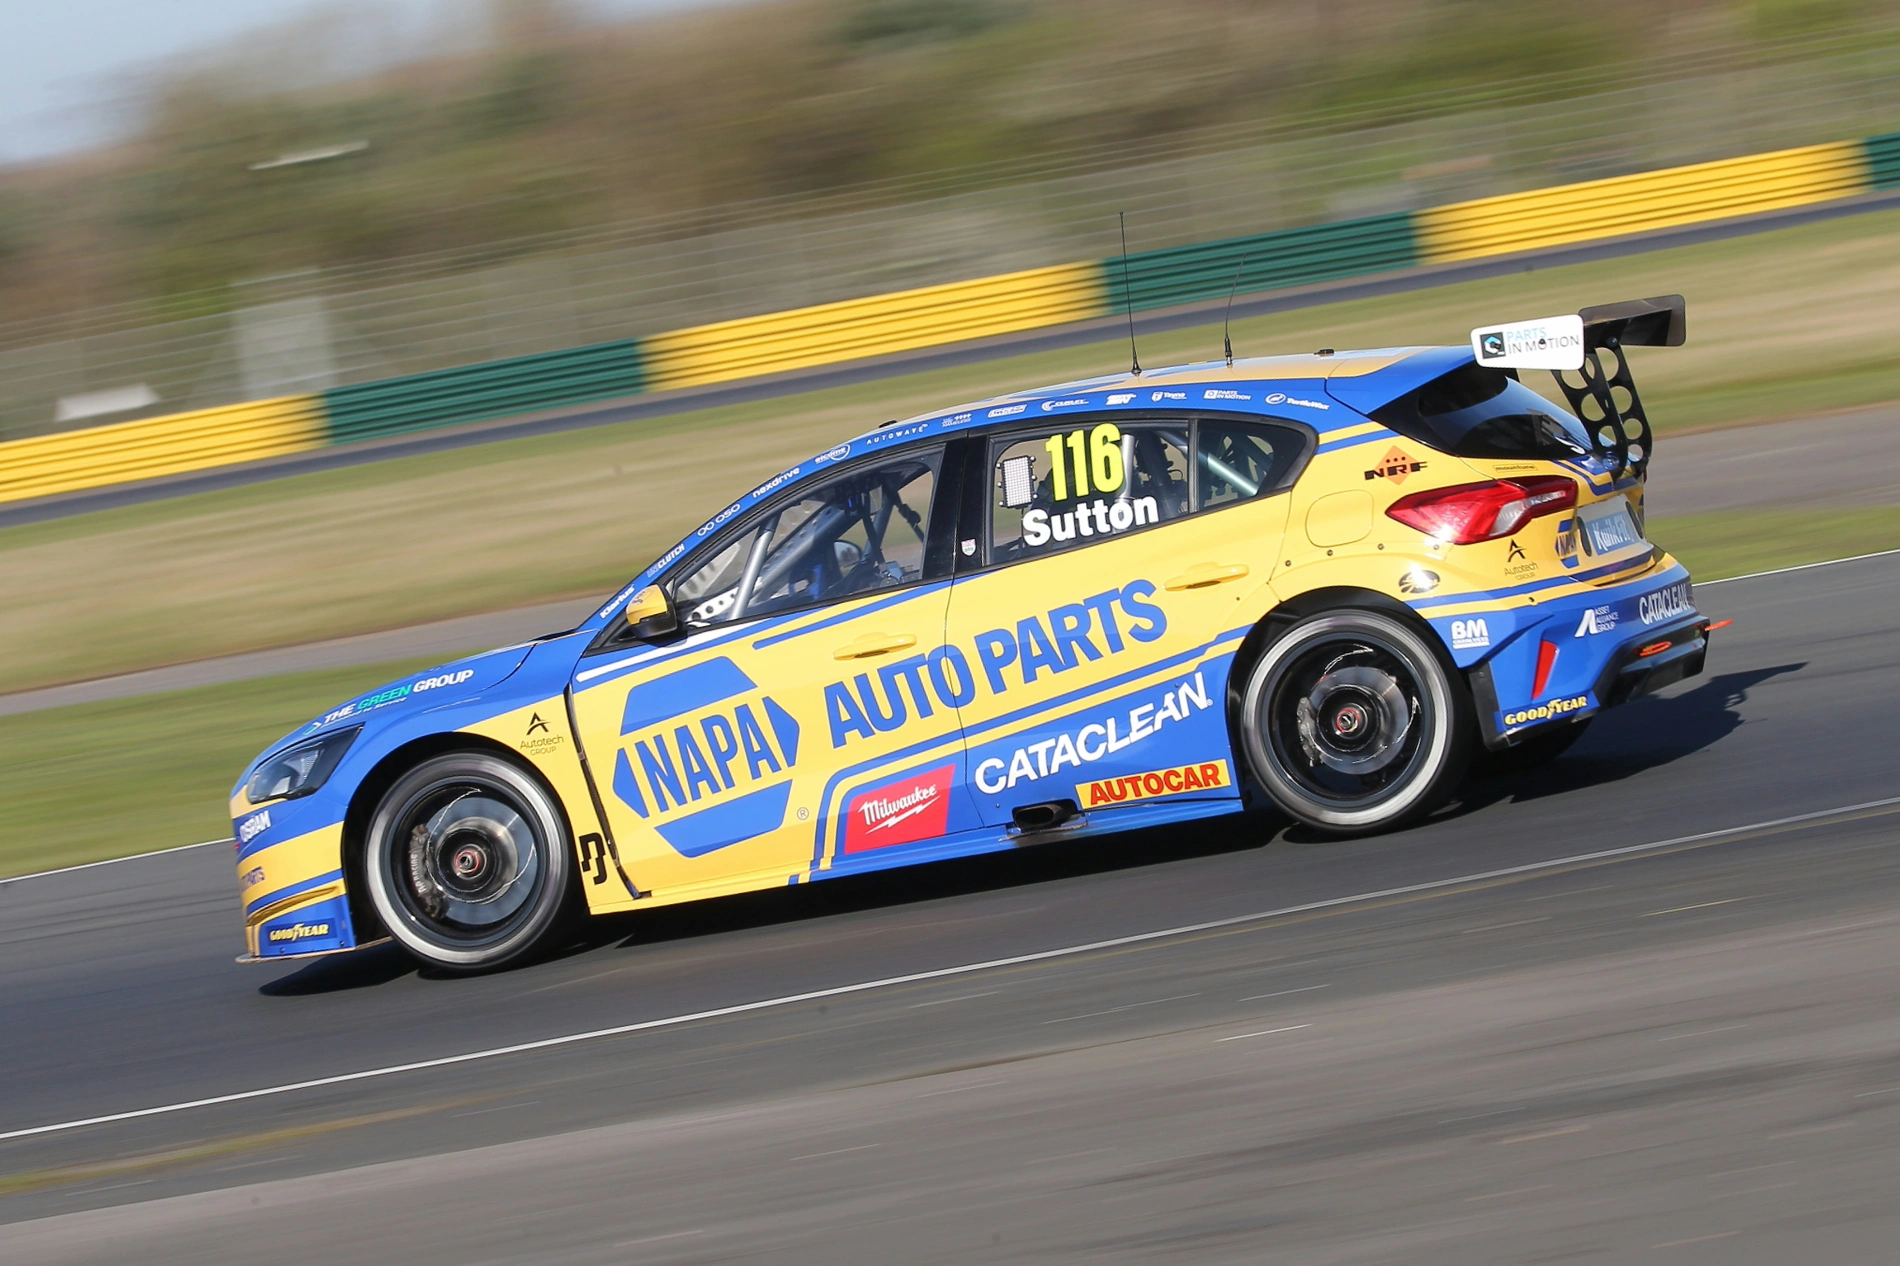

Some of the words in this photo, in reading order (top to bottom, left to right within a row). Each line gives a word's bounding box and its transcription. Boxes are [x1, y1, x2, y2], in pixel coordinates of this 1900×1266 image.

[1507, 327, 1547, 341] PARTS
[1508, 341, 1522, 354] IN
[1526, 335, 1580, 352] MOTION
[866, 425, 924, 445] AUTOWAVE
[1045, 422, 1125, 501] 116
[1364, 461, 1429, 480] NRF
[752, 467, 800, 498] nexdrive
[1022, 496, 1159, 547] Sutton
[1505, 561, 1539, 577] Autotech
[1516, 572, 1536, 581] GROUP
[600, 585, 635, 619] Klarius
[1639, 583, 1691, 625] CATACLEAN
[1451, 618, 1489, 640] BM
[823, 644, 977, 748] AUTO
[981, 579, 1168, 694] PARTS
[323, 704, 357, 725] THE
[357, 684, 412, 710] GREEN
[412, 669, 474, 693] GROUP
[1504, 696, 1587, 725] GOODYEAR
[519, 734, 564, 750] Autotech
[974, 672, 1207, 795] CATACLEAN
[530, 746, 557, 756] GROUP
[640, 710, 777, 813] NAPA
[1090, 763, 1222, 807] AUTOCAR
[859, 783, 938, 827] Milwaukee
[239, 810, 271, 843] OSRAM
[270, 923, 329, 942] GOODYEAR
